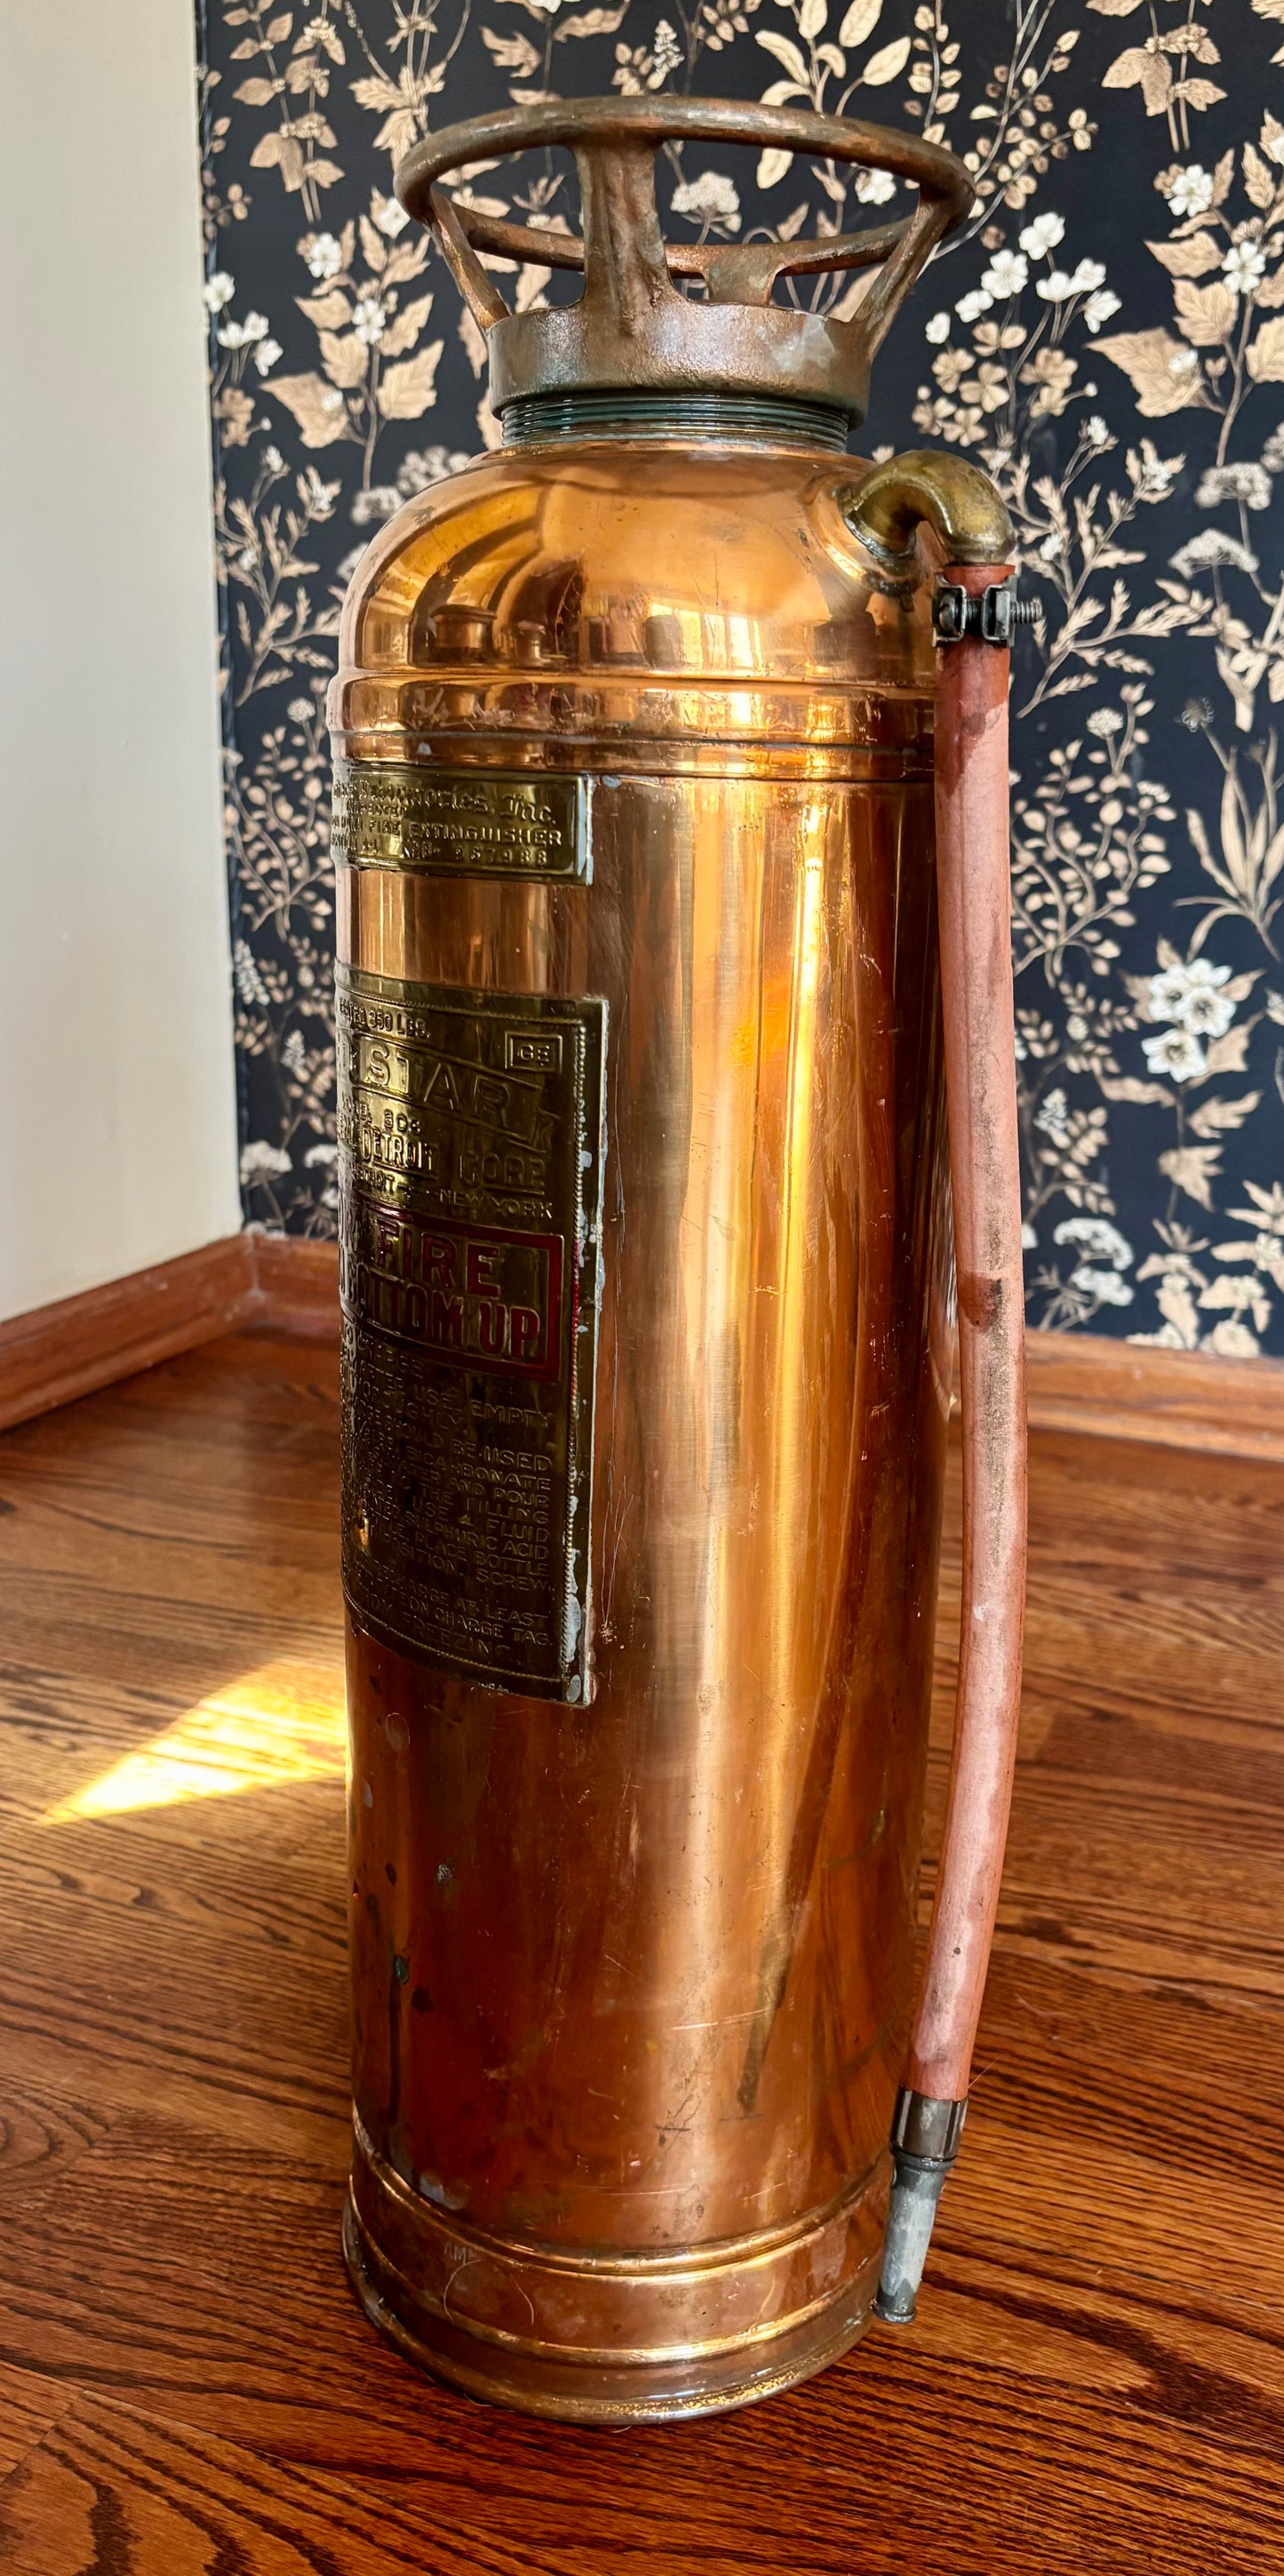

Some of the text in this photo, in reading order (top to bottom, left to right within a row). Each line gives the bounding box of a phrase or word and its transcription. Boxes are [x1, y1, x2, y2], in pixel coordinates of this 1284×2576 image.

[409, 823, 562, 846] EXTINGUISHER
[377, 1218, 500, 1298] FIRE
[477, 1298, 540, 1360] UP
[468, 1398, 555, 1429] EMPTY
[482, 1445, 553, 1472] USED
[493, 1486, 549, 1508] POUR
[486, 1518, 551, 1543] FLUID
[414, 1530, 467, 1561] PLACE
[475, 1551, 548, 1576] BOTTLE
[503, 1539, 549, 1560] ACID
[435, 1607, 503, 1639] CHARGE
[485, 1603, 548, 1628] LEAST
